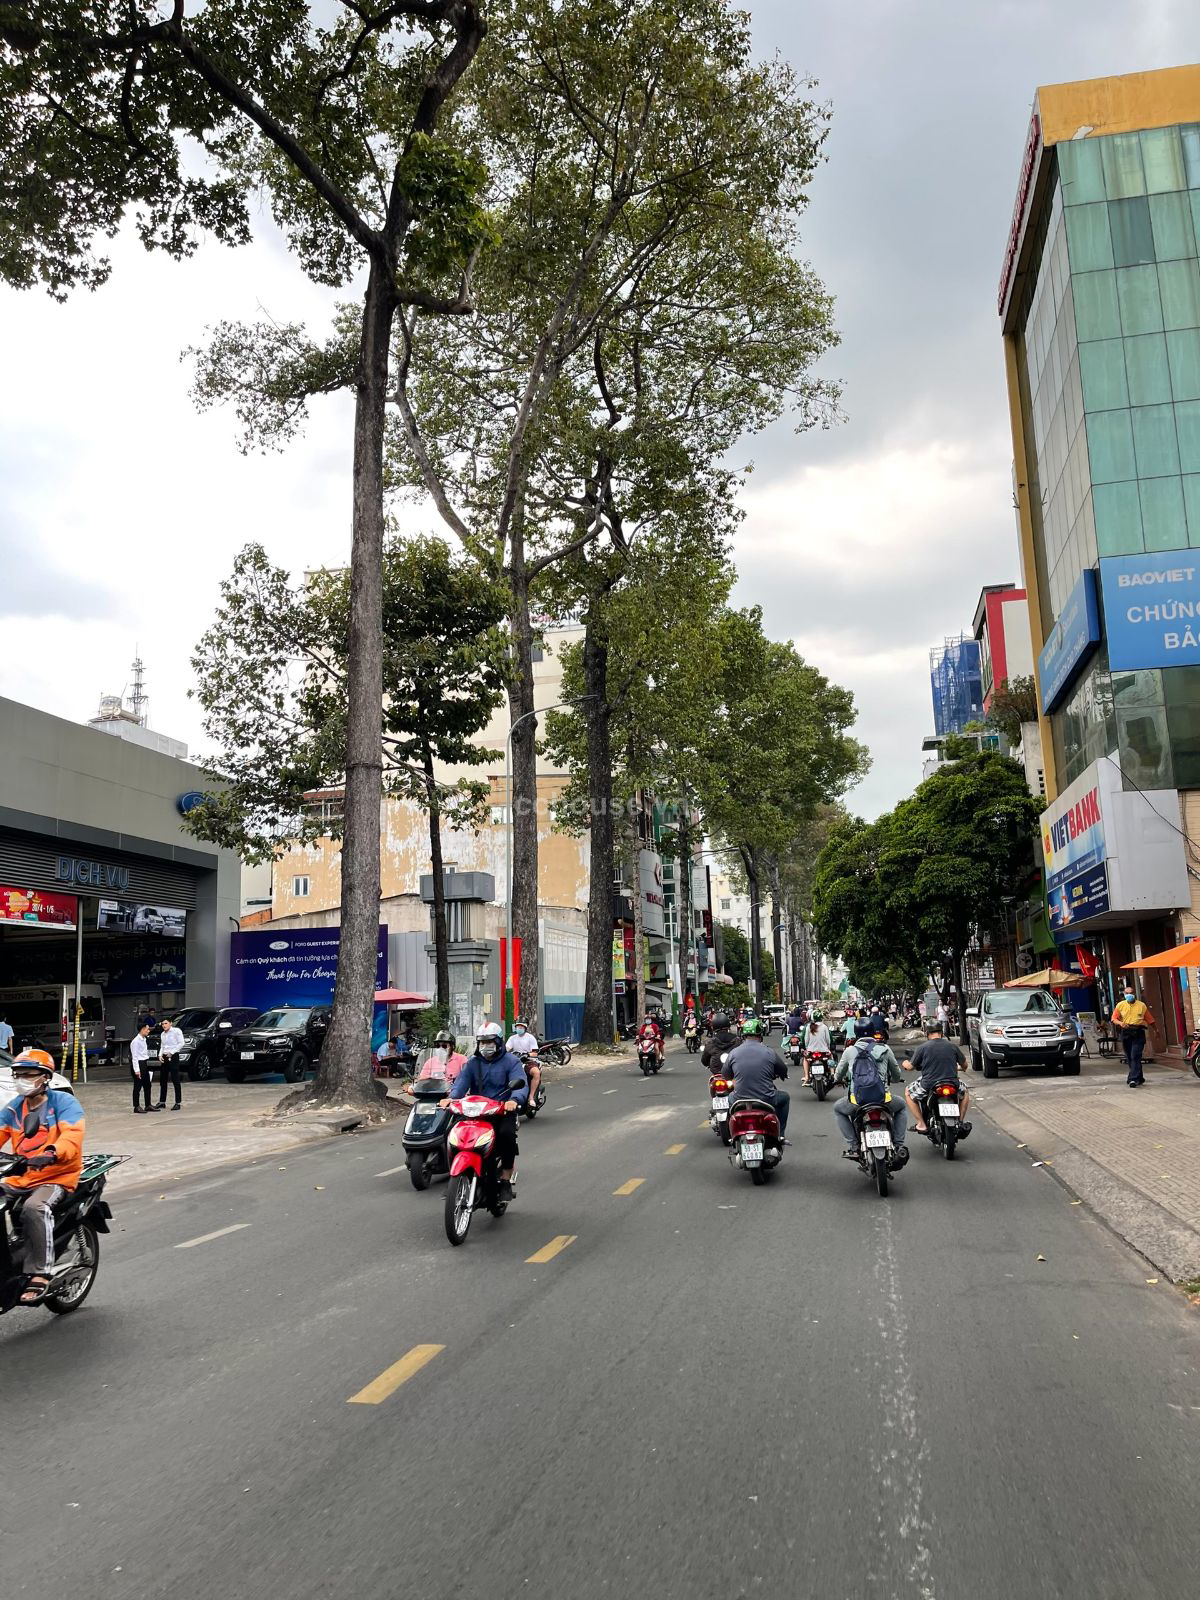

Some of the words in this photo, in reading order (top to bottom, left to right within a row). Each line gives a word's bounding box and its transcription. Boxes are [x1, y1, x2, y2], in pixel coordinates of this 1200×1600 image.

[1118, 568, 1195, 587] BAOVIET
[1164, 624, 1200, 649] BẢ
[1050, 786, 1101, 854] VIETBANK
[56, 856, 101, 887] DỊCH
[105, 865, 129, 894] VỤ
[266, 968, 286, 980] Thank
[286, 970, 299, 982] You
[300, 969, 311, 979] For
